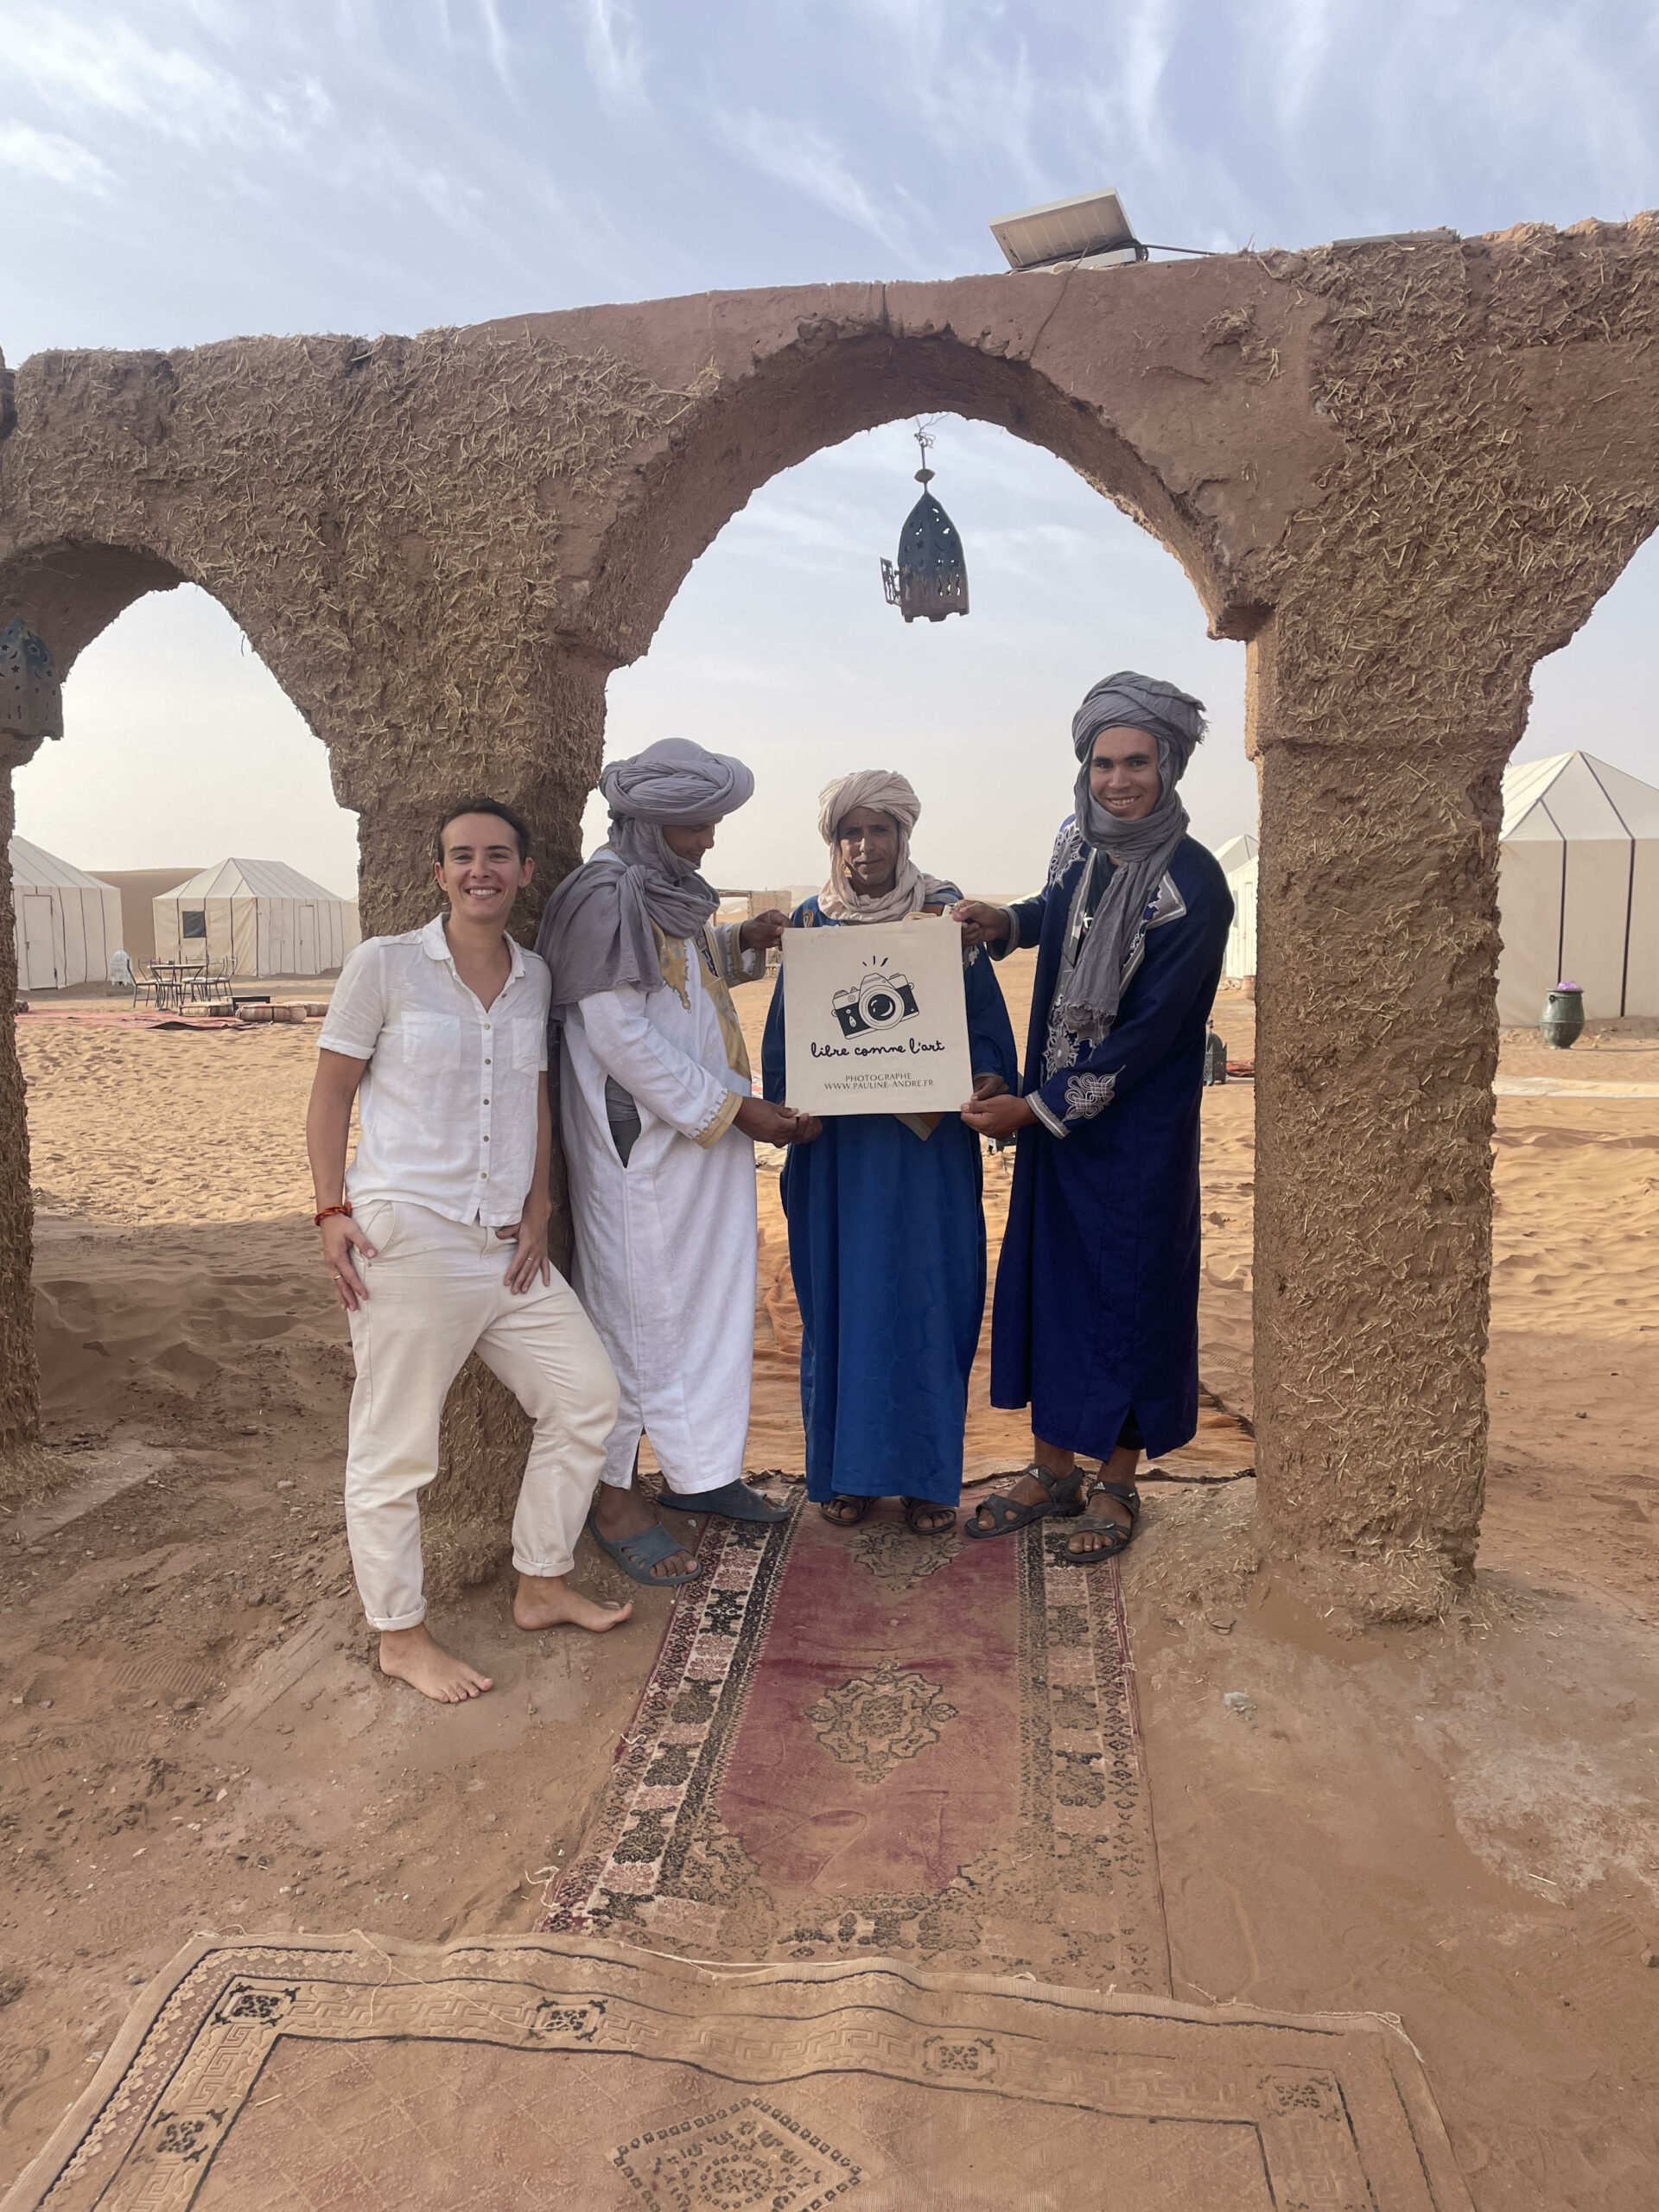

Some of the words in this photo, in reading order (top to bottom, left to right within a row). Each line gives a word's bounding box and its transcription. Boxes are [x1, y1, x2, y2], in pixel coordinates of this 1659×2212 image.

[810, 1042, 849, 1058] libre
[855, 1045, 906, 1056] comme
[909, 1038, 945, 1054] l'art
[845, 1072, 912, 1082] PHOTOGRAPHE
[823, 1079, 934, 1090] WWW.PAULINE-ANDRE.FR
